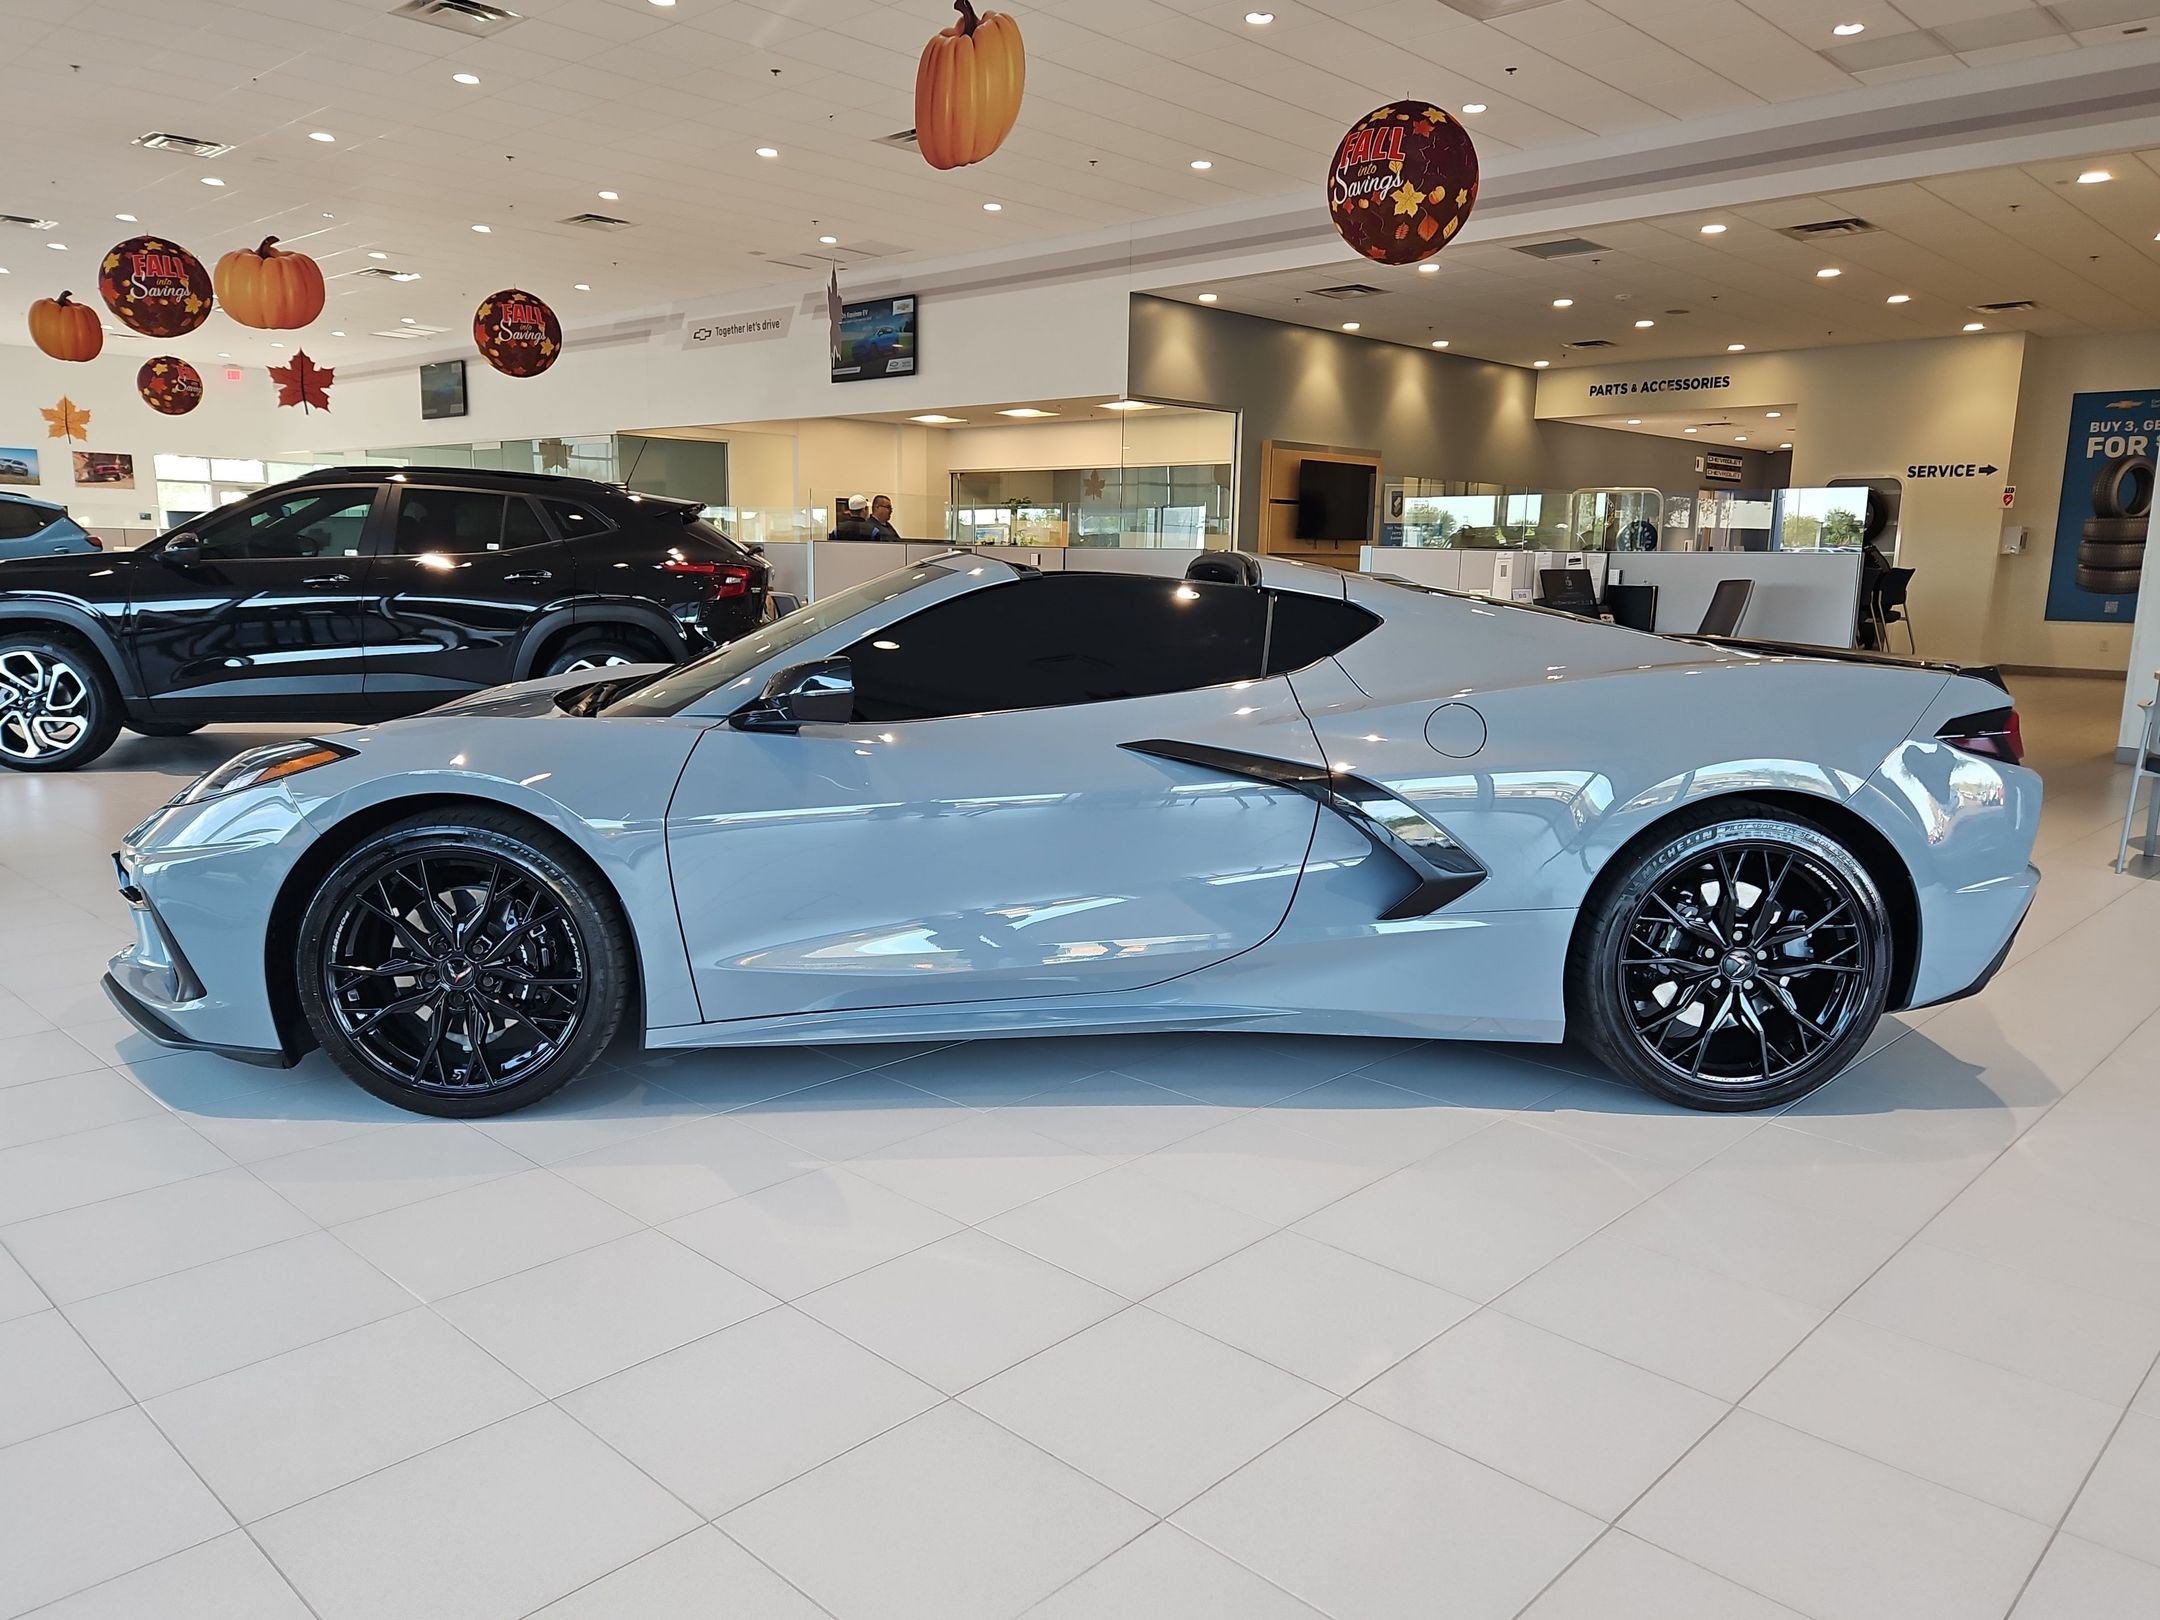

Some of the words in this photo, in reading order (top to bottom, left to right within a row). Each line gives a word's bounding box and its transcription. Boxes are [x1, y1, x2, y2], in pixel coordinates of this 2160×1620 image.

[1340, 126, 1406, 169] FALL
[1357, 162, 1378, 177] into
[1333, 158, 1404, 205] Savings
[132, 254, 190, 282] FALL
[130, 271, 192, 303] Savings
[156, 278, 173, 287] into
[501, 303, 546, 325] FALL
[498, 318, 546, 346] Savings
[715, 323, 746, 338] Together
[746, 321, 762, 334] let's
[762, 319, 781, 331] drive
[1589, 383, 1629, 397] PARTS
[1631, 384, 1638, 393] &
[1640, 375, 1731, 393] ACCESSORIES
[2089, 421, 2122, 433] BUY
[2124, 420, 2139, 433] 3,
[2086, 435, 2149, 459] FOR
[1907, 464, 1976, 478] SERVICE
[1724, 824, 1749, 832] PILOT
[1752, 823, 1779, 831] SPORT
[1641, 829, 1713, 880] MICHELIN
